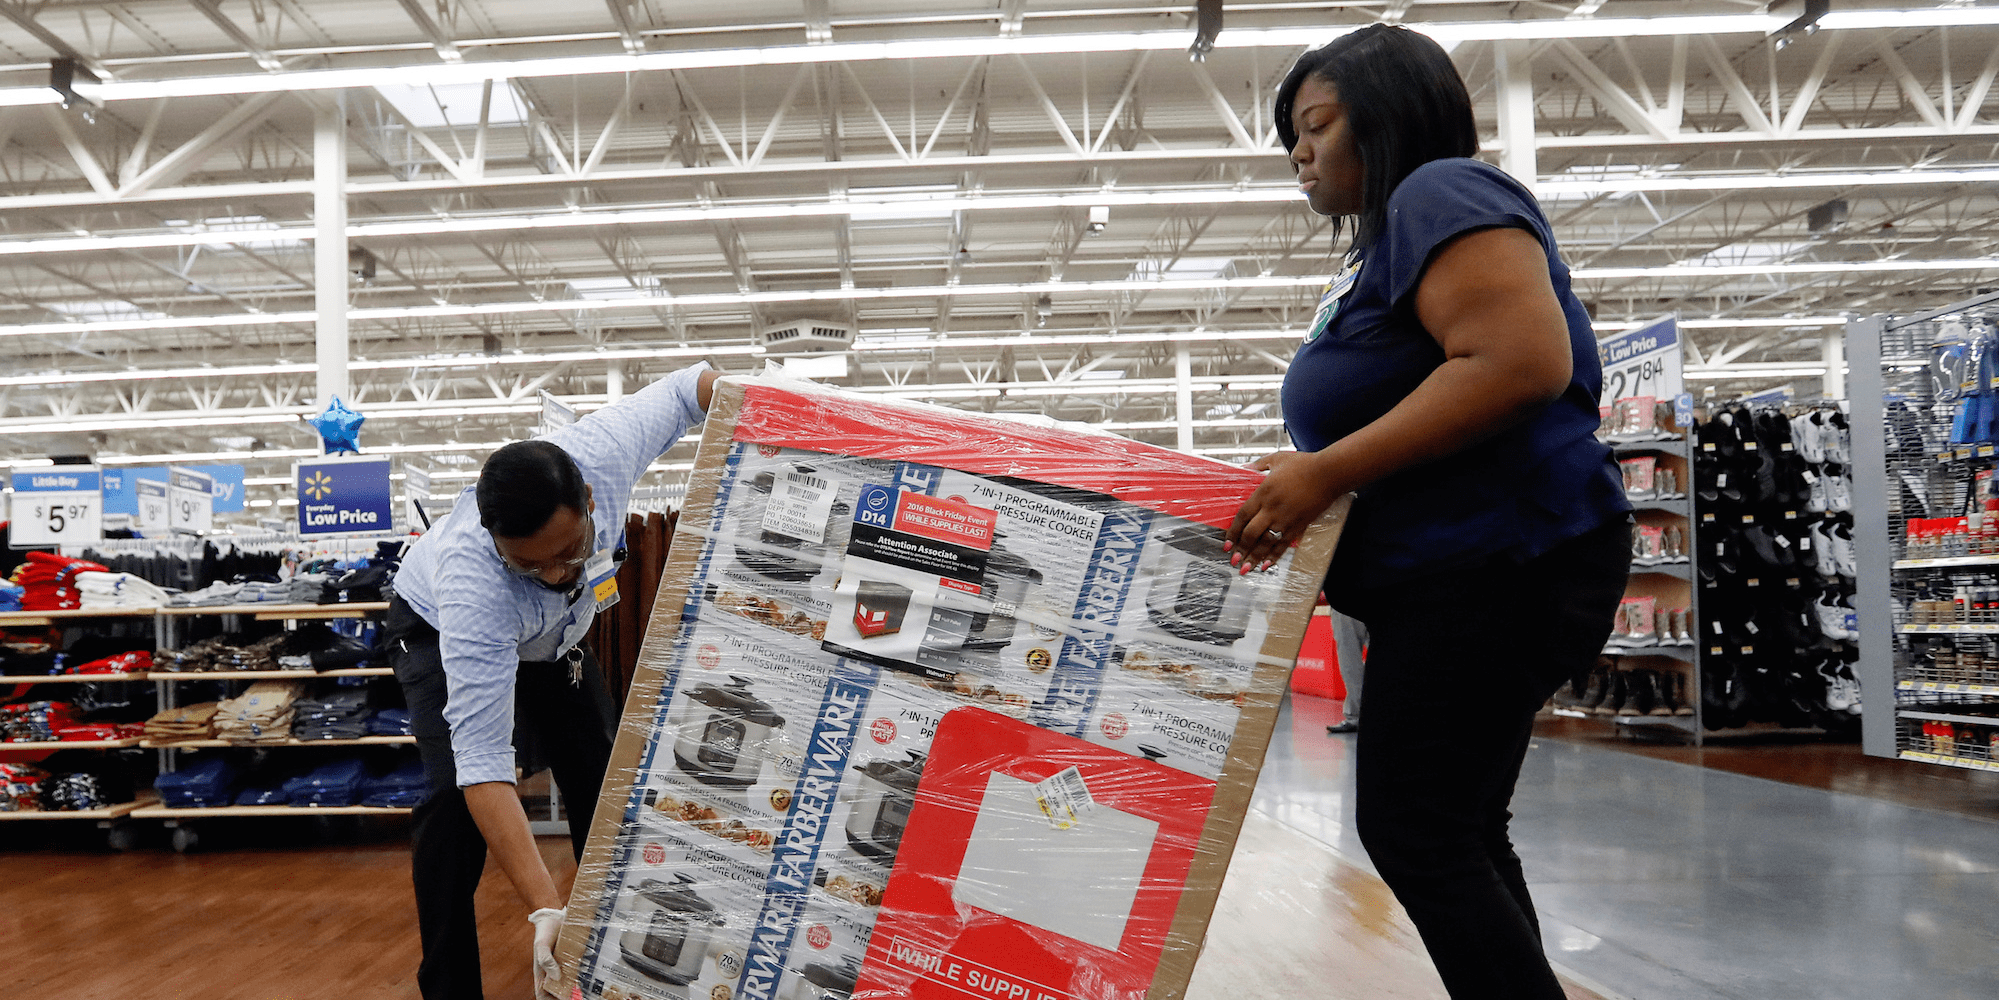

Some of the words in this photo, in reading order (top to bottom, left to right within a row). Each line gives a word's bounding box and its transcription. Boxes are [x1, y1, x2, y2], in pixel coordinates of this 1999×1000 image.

[1610, 345, 1631, 362] Low
[1631, 336, 1657, 355] Price
[1678, 395, 1688, 409] C
[1675, 412, 1692, 424] 30
[306, 511, 338, 527] Low
[339, 508, 378, 525] Price
[765, 510, 775, 518] PO
[767, 503, 784, 512] DEPT
[786, 508, 806, 519] 00014
[861, 510, 887, 525] D14
[907, 502, 924, 513] 2016
[924, 507, 944, 517] Black
[944, 510, 967, 523] Friday
[967, 515, 988, 527] Event
[1005, 493, 1098, 529] PROGRAMMABLE
[763, 517, 780, 526] ITEM
[905, 513, 930, 525] WHILE
[929, 518, 964, 532] SUPPLIES
[964, 525, 986, 537] LAST
[994, 504, 1047, 528] PRESSURE
[1048, 520, 1094, 541] COOKER
[877, 536, 917, 552] Attention
[918, 545, 958, 561] Associate
[926, 669, 946, 679] Walmart
[899, 707, 930, 725] 7-IN-1
[1152, 723, 1208, 749] PRESSURE
[775, 682, 861, 889] FARBERWARE
[722, 797, 752, 814] FRACTION
[808, 937, 827, 948] LAST
[896, 944, 963, 982] WHILE
